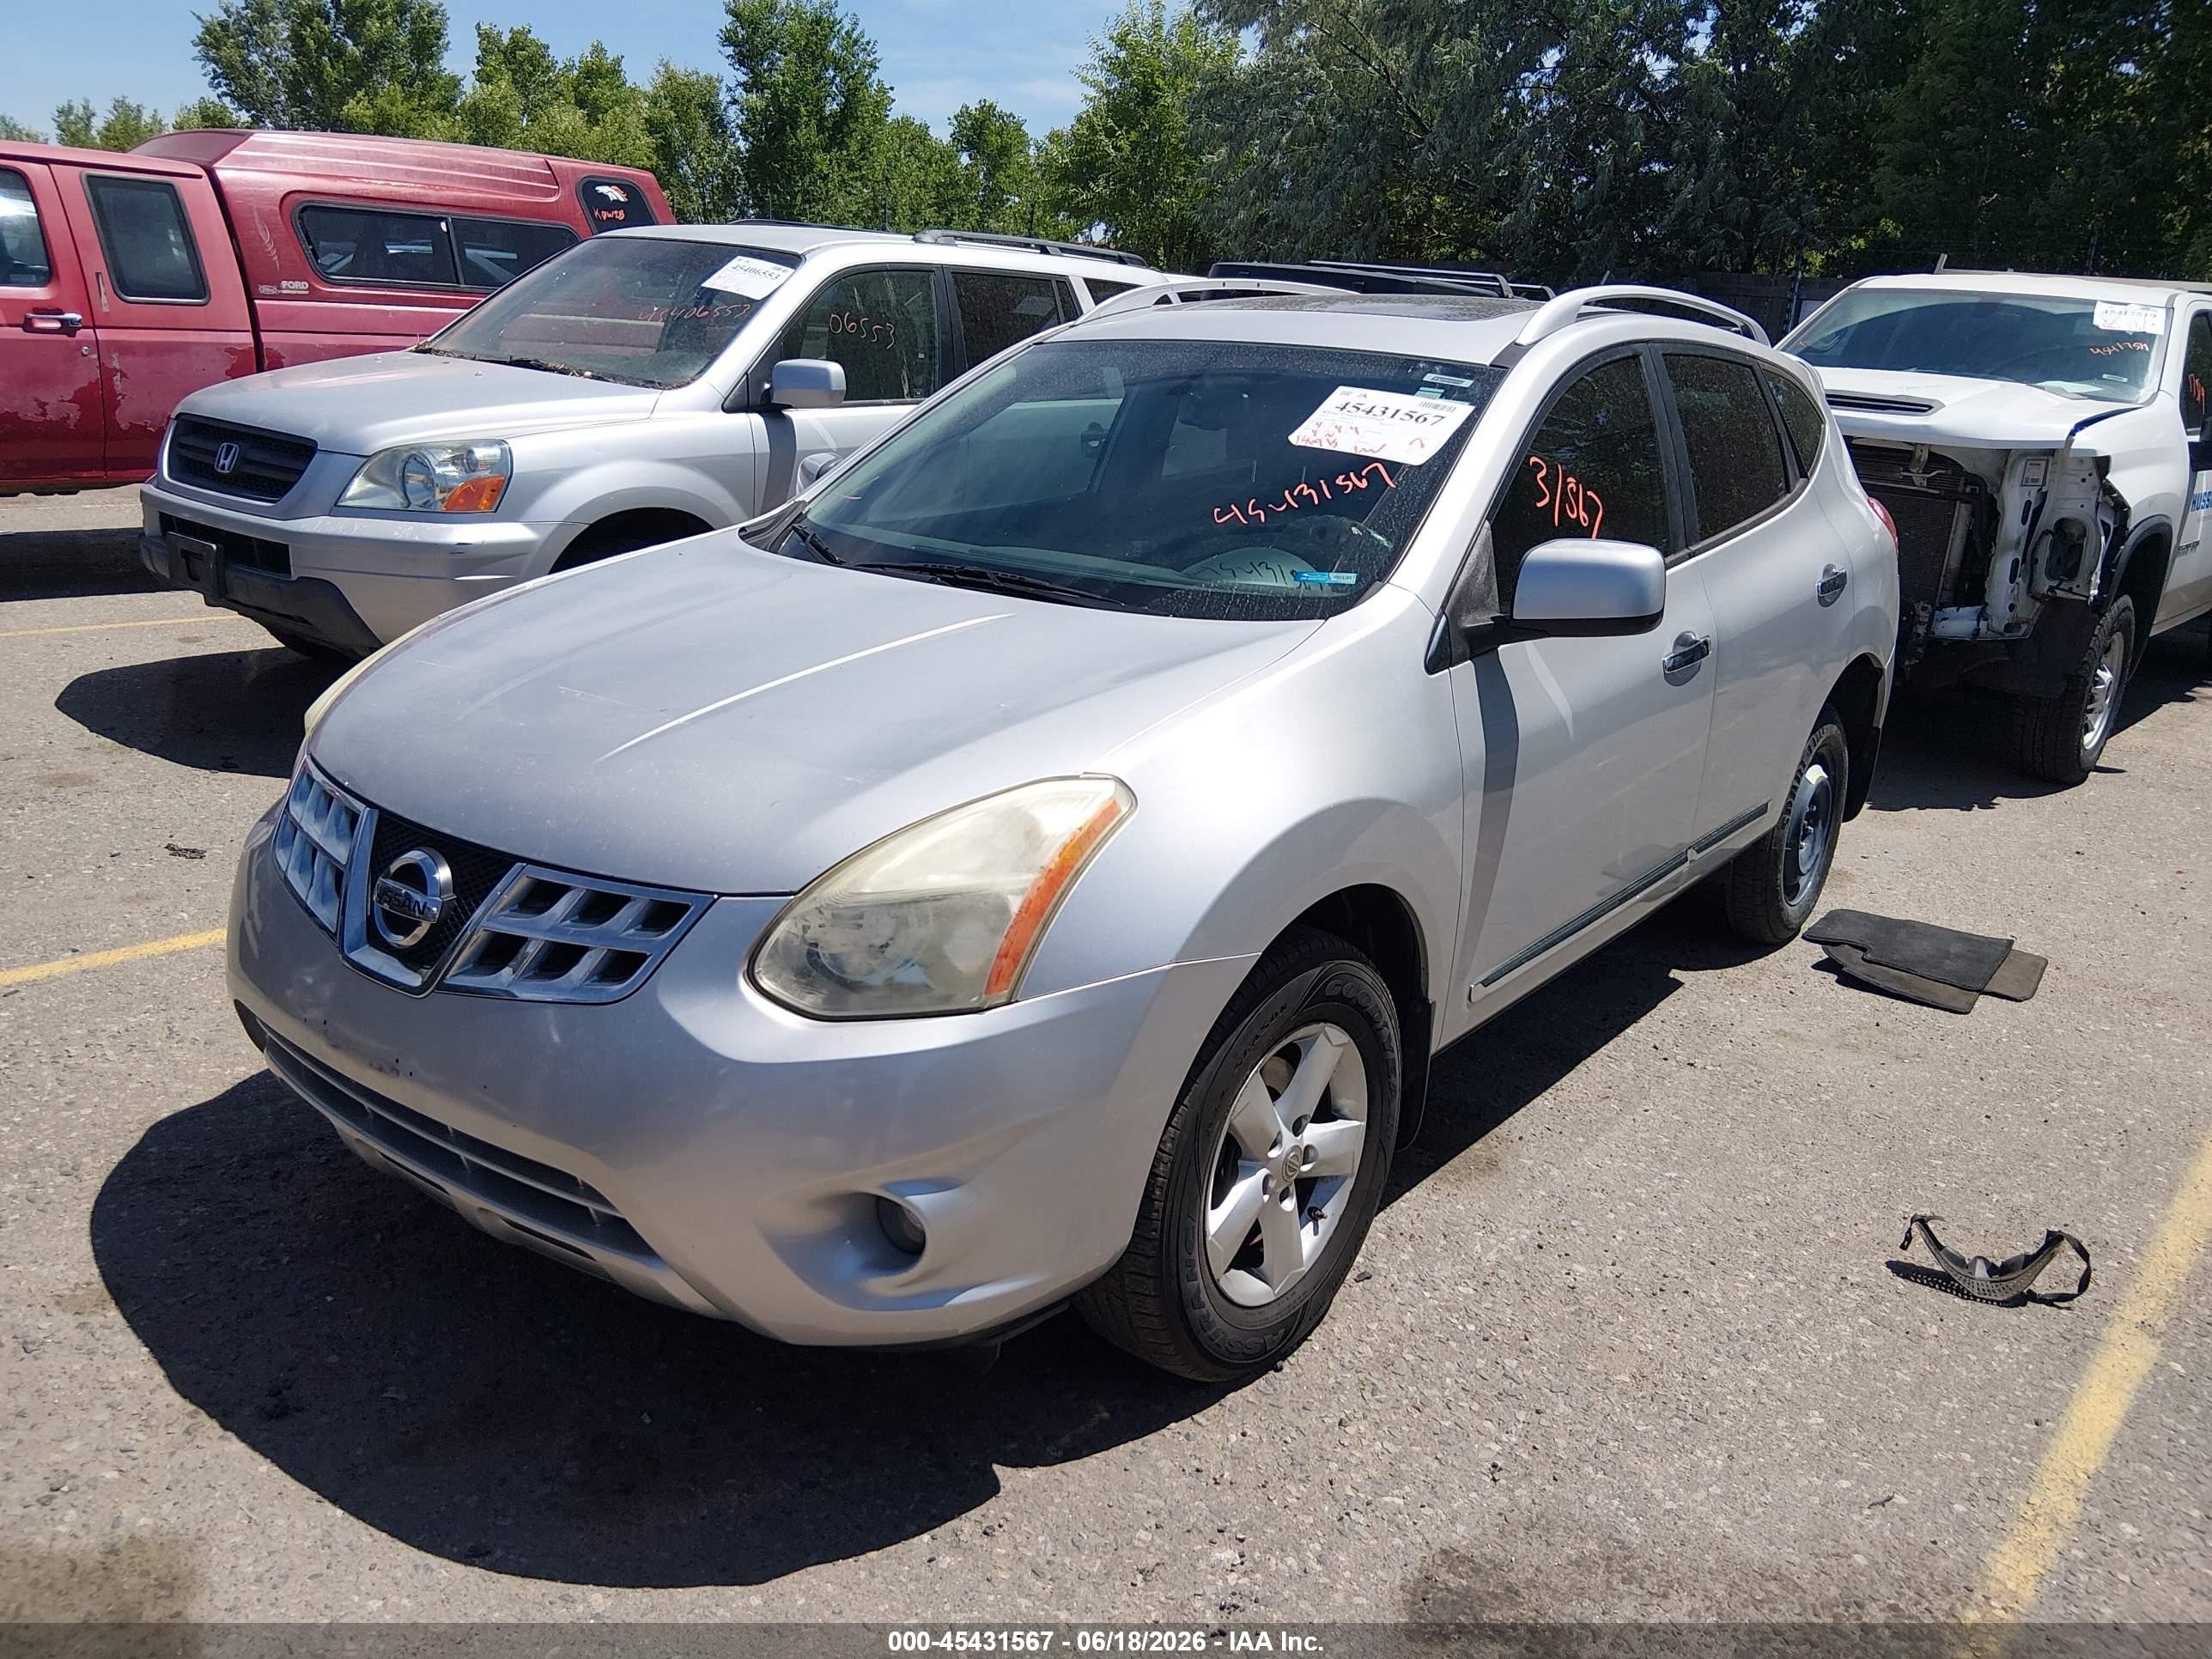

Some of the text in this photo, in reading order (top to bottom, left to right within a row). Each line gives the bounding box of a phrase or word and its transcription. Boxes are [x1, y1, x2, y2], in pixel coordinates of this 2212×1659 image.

[281, 280, 309, 289] FORD
[638, 304, 750, 322] 45406553
[830, 312, 895, 350] 06553
[1335, 400, 1447, 427] 45431567
[1213, 462, 1397, 525] 45431567
[1529, 456, 1603, 539] 31567
[2191, 490, 2212, 513] HUSS
